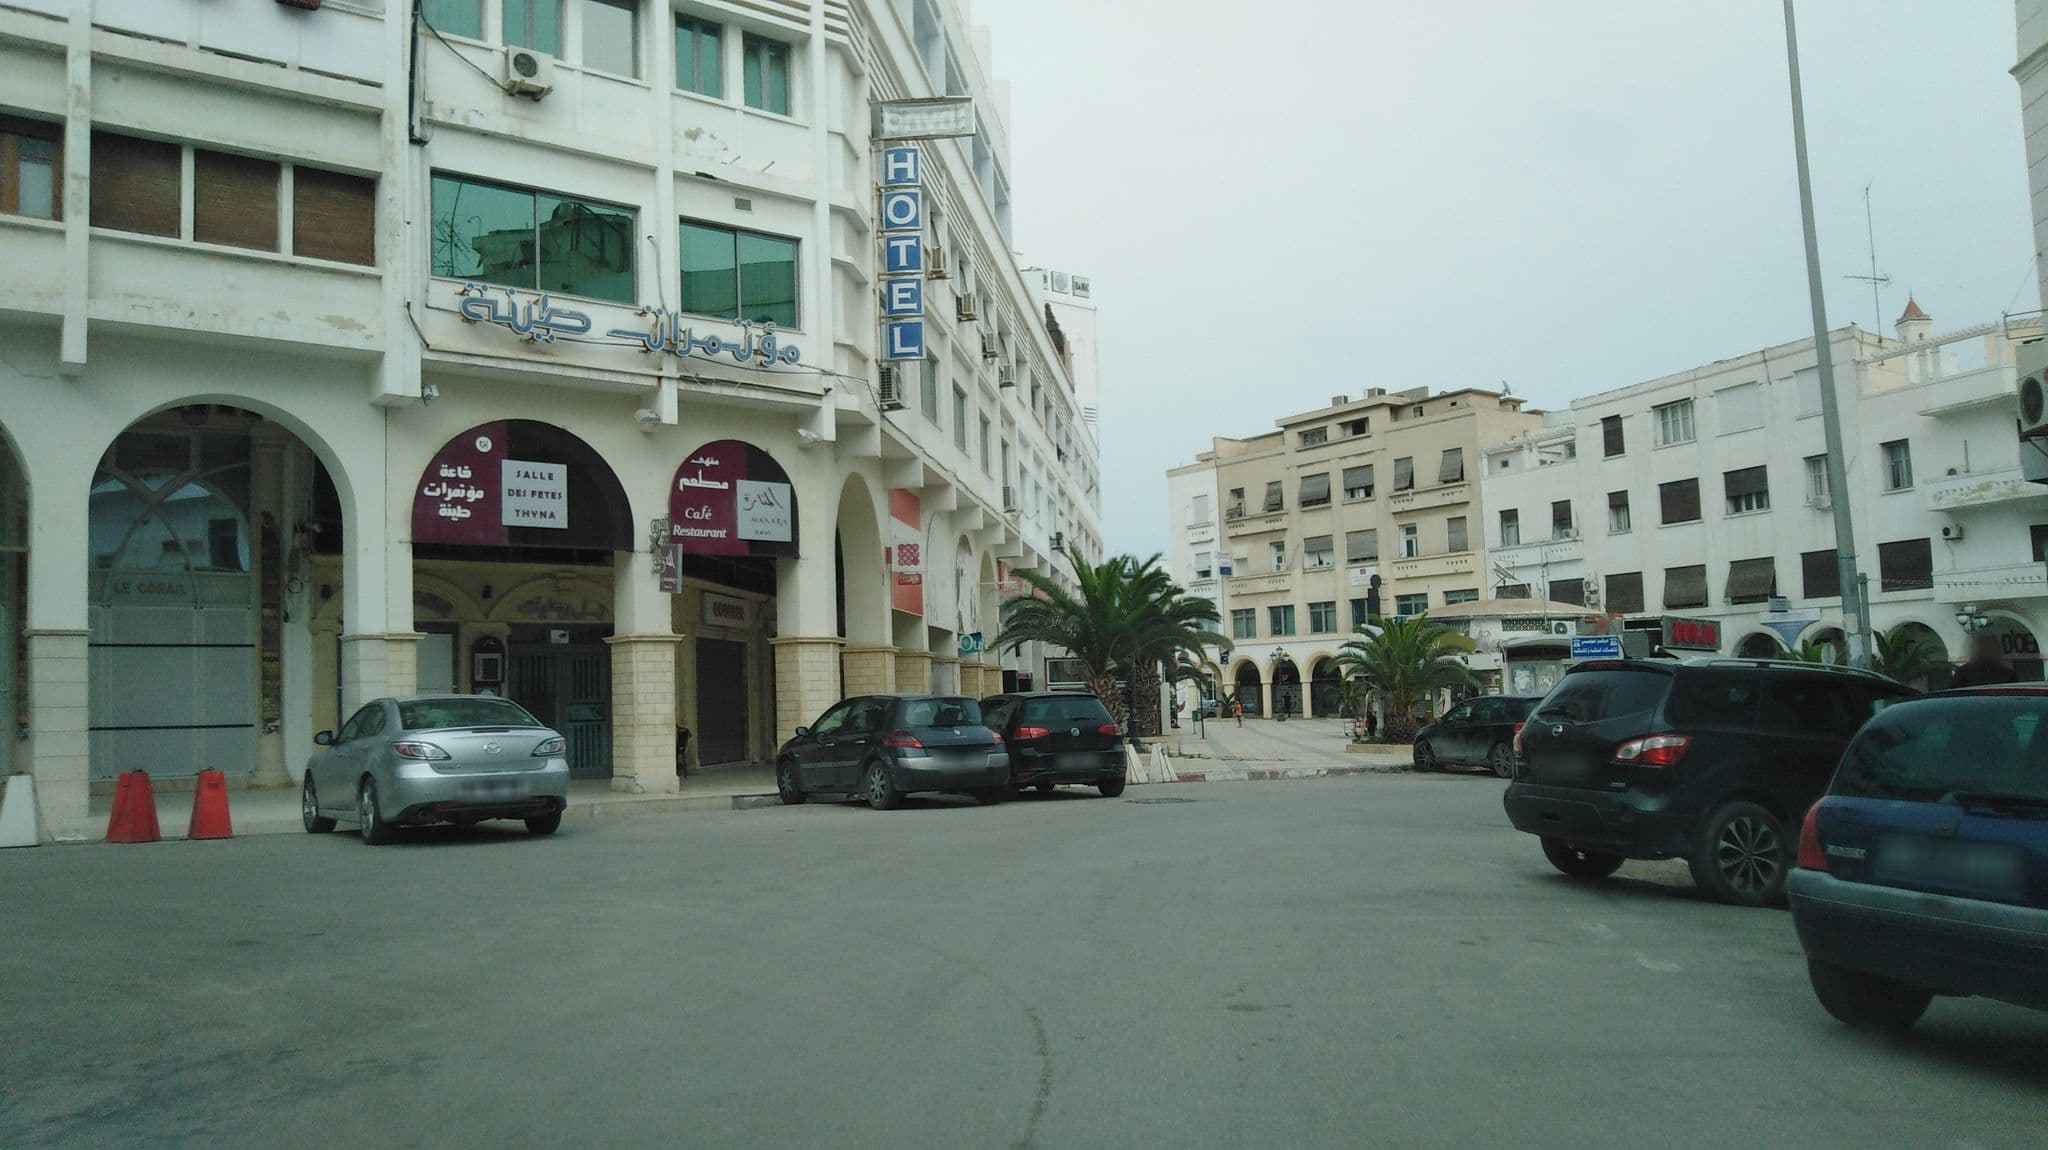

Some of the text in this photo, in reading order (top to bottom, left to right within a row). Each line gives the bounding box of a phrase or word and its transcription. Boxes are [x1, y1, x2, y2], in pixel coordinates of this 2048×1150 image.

[886, 150, 919, 355] HOTEL
[459, 281, 802, 366] مؤتمرات طينة
[439, 464, 472, 479] قاعة
[515, 470, 555, 481] SALLE
[678, 469, 729, 491] مطعم
[423, 482, 484, 503] مؤتمرات
[507, 488, 563, 500] DES FETES
[438, 503, 472, 521] طينة
[685, 504, 713, 520] Café
[673, 524, 727, 539] Restaurant
